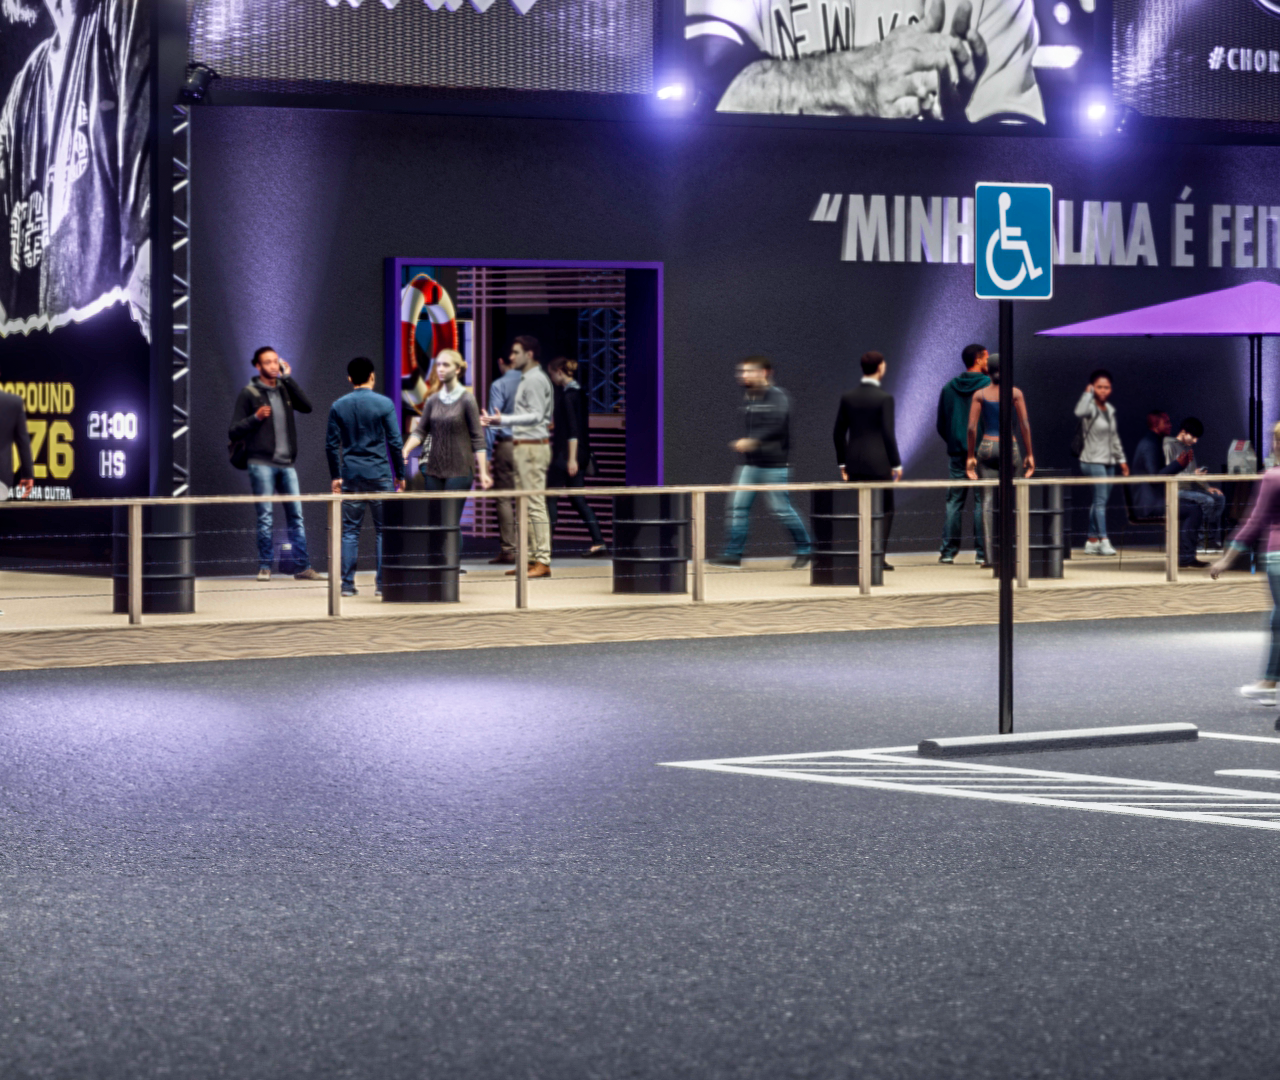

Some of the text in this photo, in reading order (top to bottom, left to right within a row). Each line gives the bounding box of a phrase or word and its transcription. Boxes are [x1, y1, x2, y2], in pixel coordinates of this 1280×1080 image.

[809, 193, 975, 264] “MINH
[1051, 199, 1159, 267] LMA
[1171, 185, 1195, 268] É
[87, 410, 138, 440] 21:00
[99, 448, 126, 479] HS
